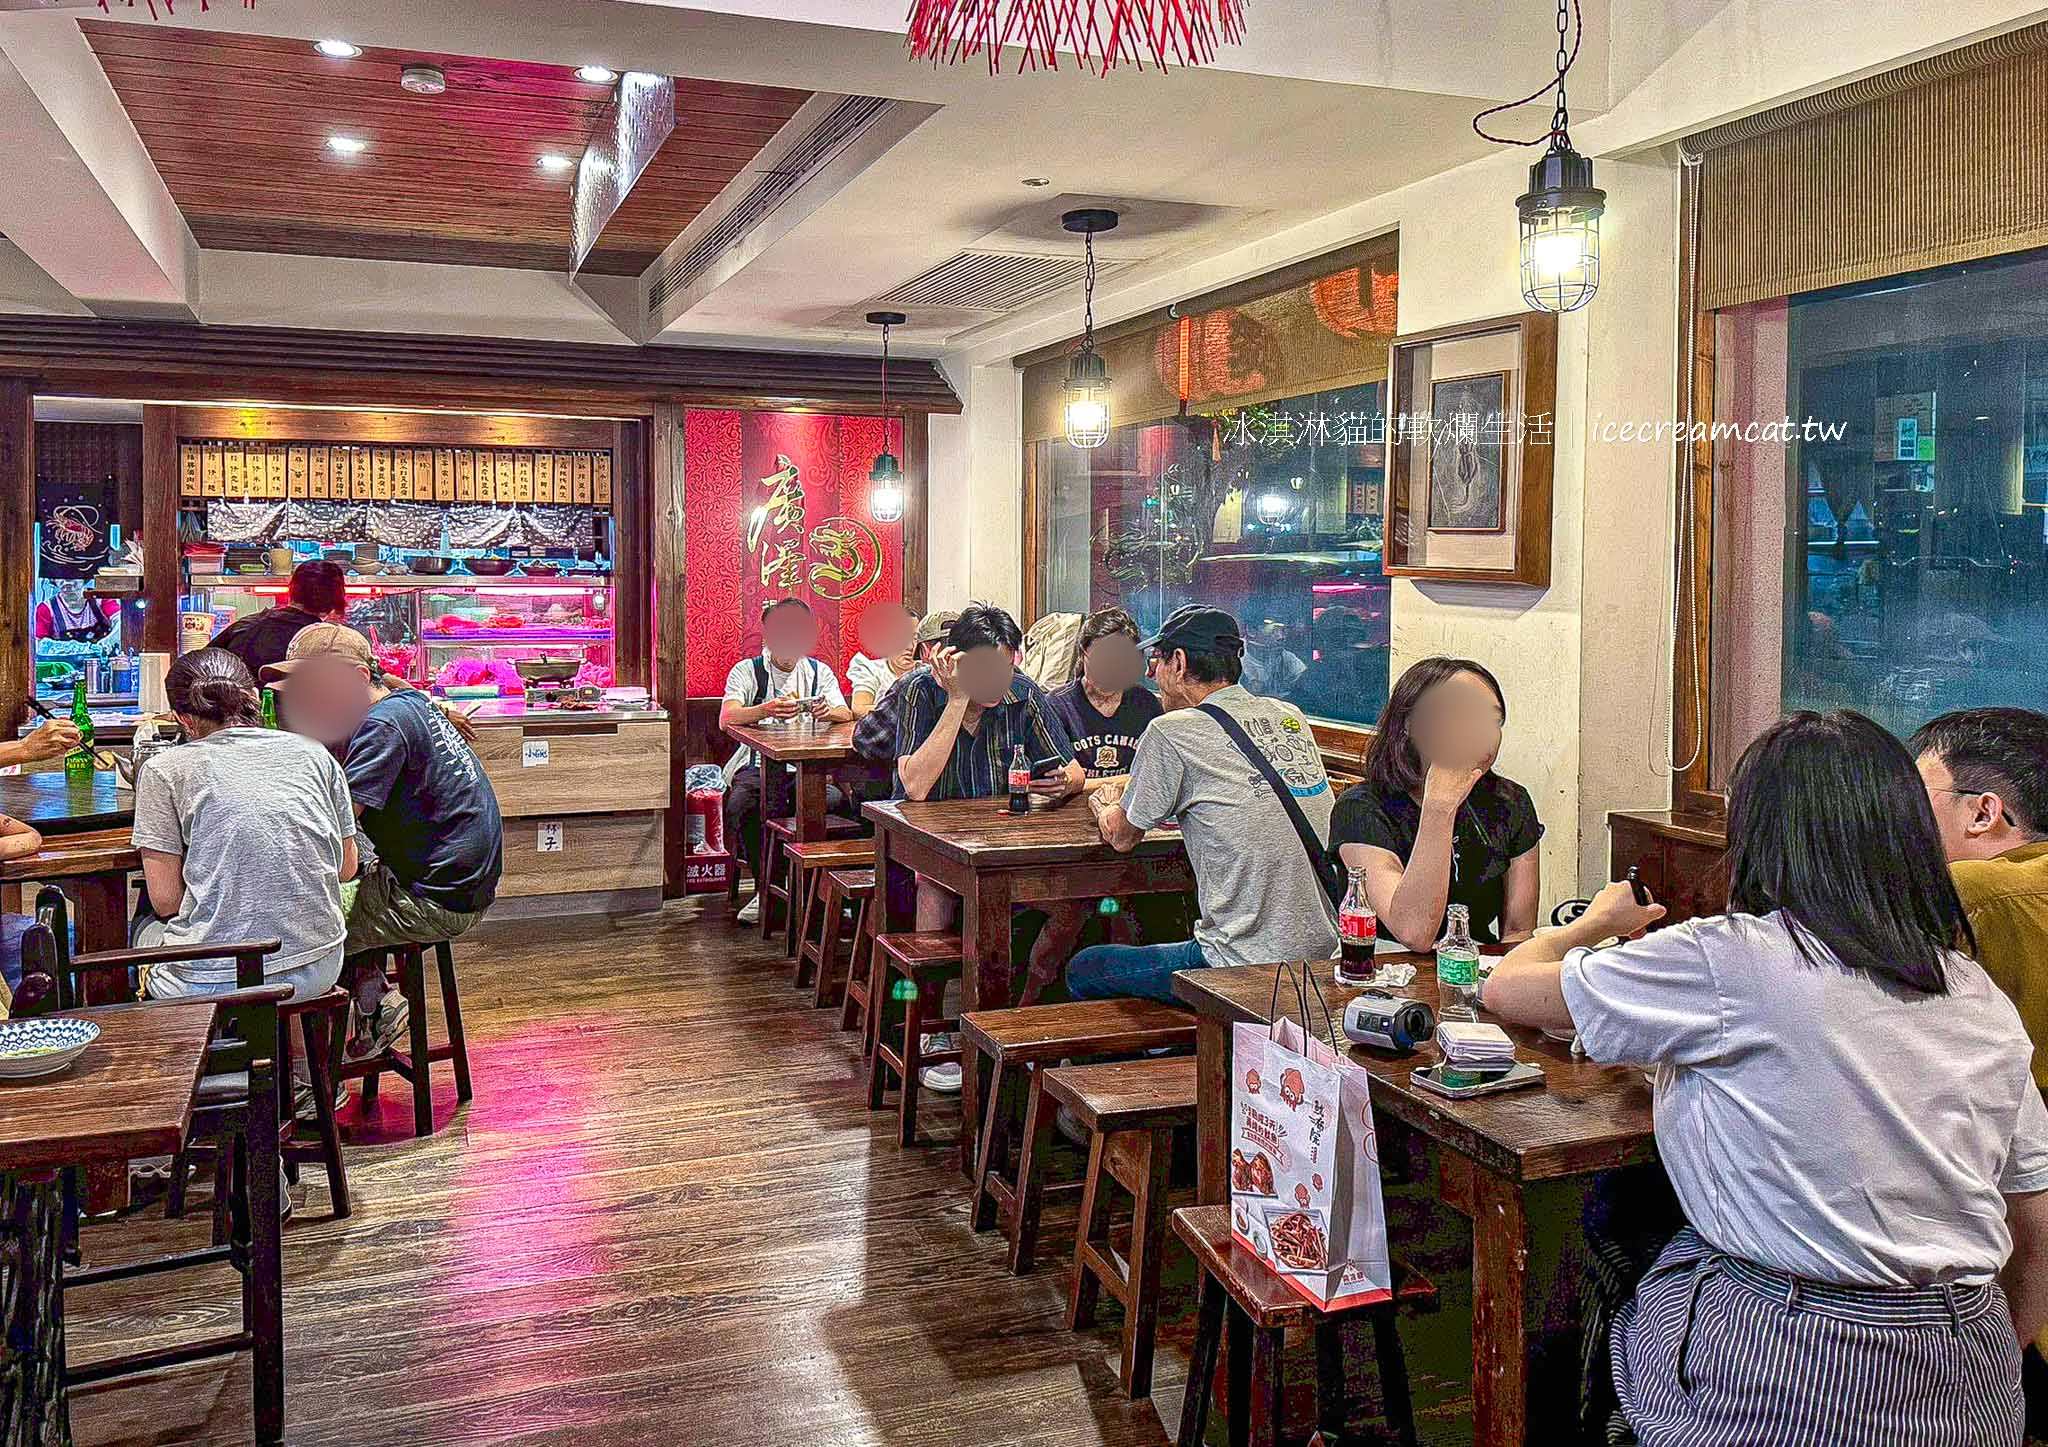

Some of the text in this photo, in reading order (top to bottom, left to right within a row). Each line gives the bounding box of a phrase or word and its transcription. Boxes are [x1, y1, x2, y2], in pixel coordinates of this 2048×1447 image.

[746, 453, 807, 591] 廣澤
[1073, 736, 1101, 751] OOTS
[687, 863, 726, 877] 滅火器
